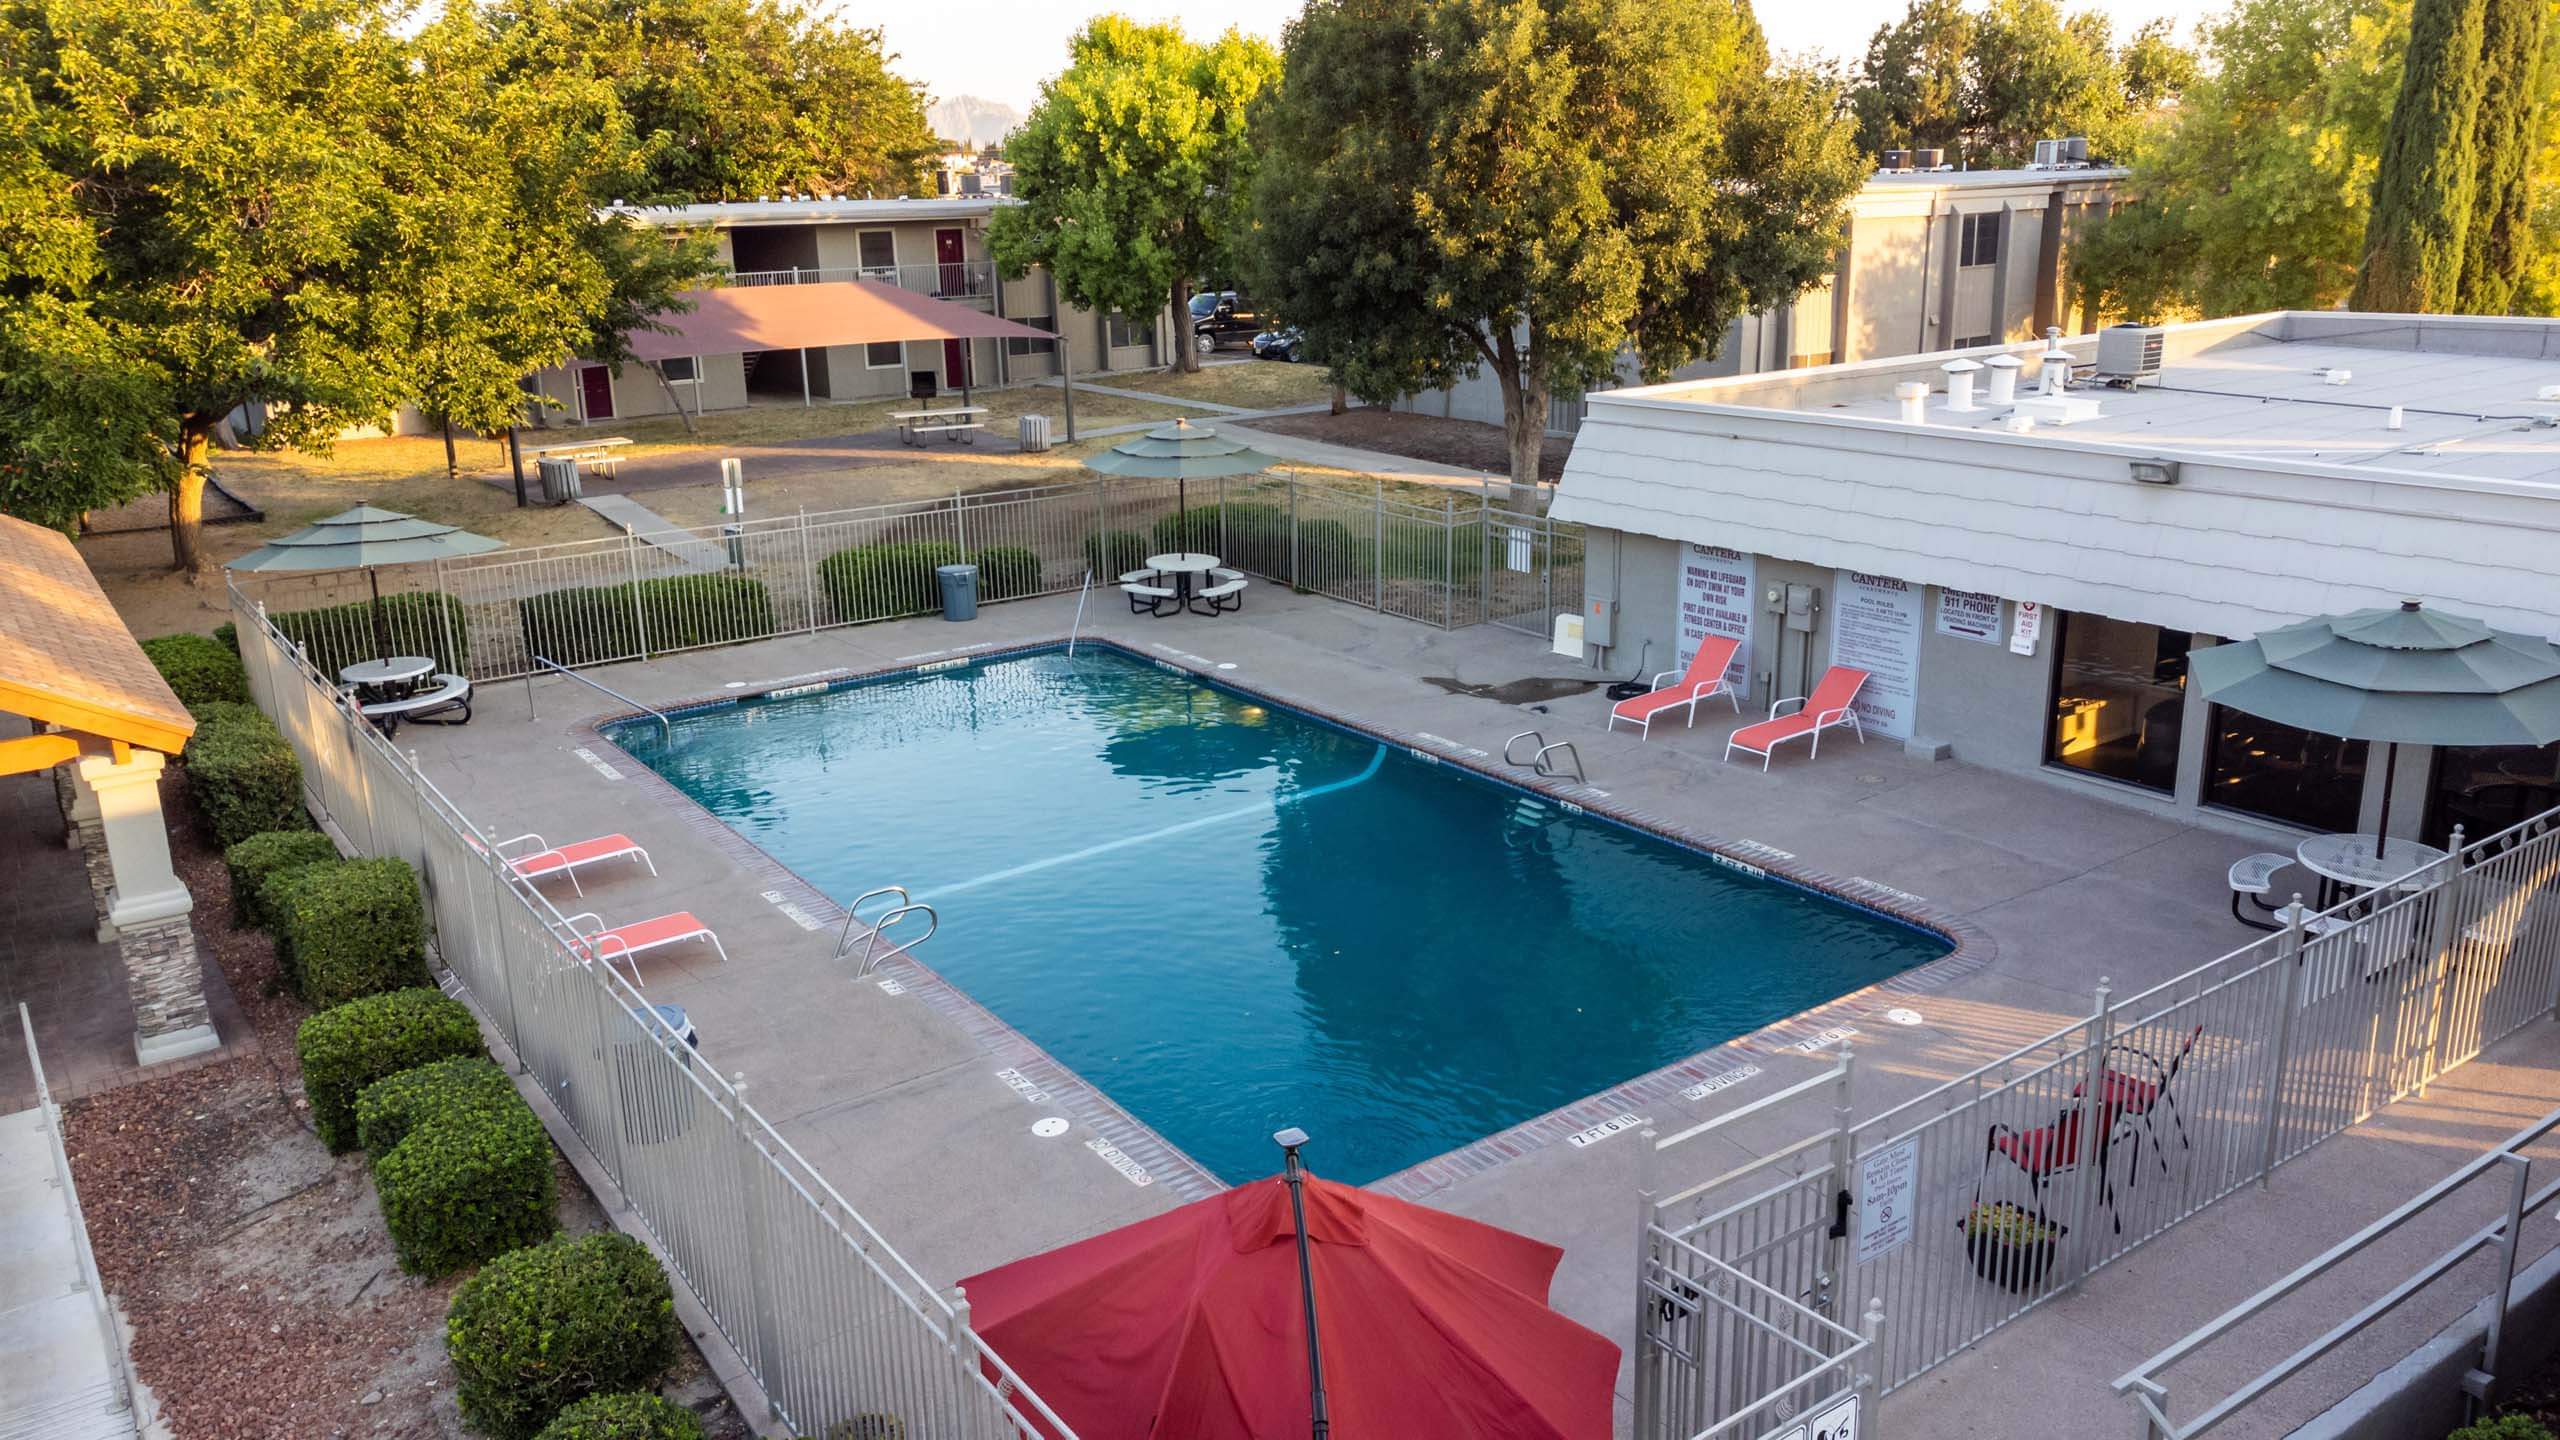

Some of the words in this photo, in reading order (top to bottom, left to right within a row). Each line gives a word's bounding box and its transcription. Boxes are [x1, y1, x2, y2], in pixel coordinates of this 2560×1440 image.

[1693, 544, 1742, 561] CANTERA
[1687, 566, 1709, 579] WARNING
[1710, 570, 1717, 580] NO
[1718, 571, 1746, 586] LIFEGUARD
[1851, 572, 1908, 592] CANTERA
[1686, 577, 1693, 587] ON
[1694, 579, 1707, 590] DUTY
[1708, 581, 1722, 593] SWIM
[1731, 586, 1744, 597] YOUR
[1702, 592, 1714, 603] OWN
[1715, 594, 1727, 605] RISK
[1944, 596, 1959, 607] 911
[1963, 600, 1996, 615] PHONE
[1683, 602, 1696, 613] FIRST
[1697, 605, 1706, 615] AID
[1706, 607, 1715, 617] KIT
[1715, 609, 1741, 623] AVAILABLE
[1940, 607, 1964, 618] LOCATED
[1972, 612, 1990, 622] FRONT
[2019, 611, 2037, 620] FIRST
[1684, 613, 1703, 626] FITNESS
[1704, 618, 1722, 630] CENTER
[1728, 623, 1745, 635] OFFICE
[1943, 615, 1965, 625] VENDING
[1967, 619, 1995, 631] MACHINES
[2021, 620, 2033, 628] AID
[1861, 702, 1872, 713] NO
[1872, 704, 1896, 719] DIVING
[1798, 1042, 1811, 1050] 7
[1825, 1031, 1839, 1039] 6
[1681, 1088, 1702, 1099] NO
[1703, 1070, 1745, 1091] DIVING
[1572, 1134, 1585, 1144] 7
[1585, 1128, 1606, 1140] FT
[1605, 1122, 1620, 1131] 6
[1618, 1114, 1639, 1126] IN
[1104, 1150, 1143, 1177] DIVING
[1866, 1164, 1890, 1181] Remain
[1891, 1151, 1911, 1168] Closed
[1873, 1156, 1889, 1169] Gate
[1890, 1164, 1908, 1177] Times
[1867, 1181, 1908, 1207] 8am-10pm
